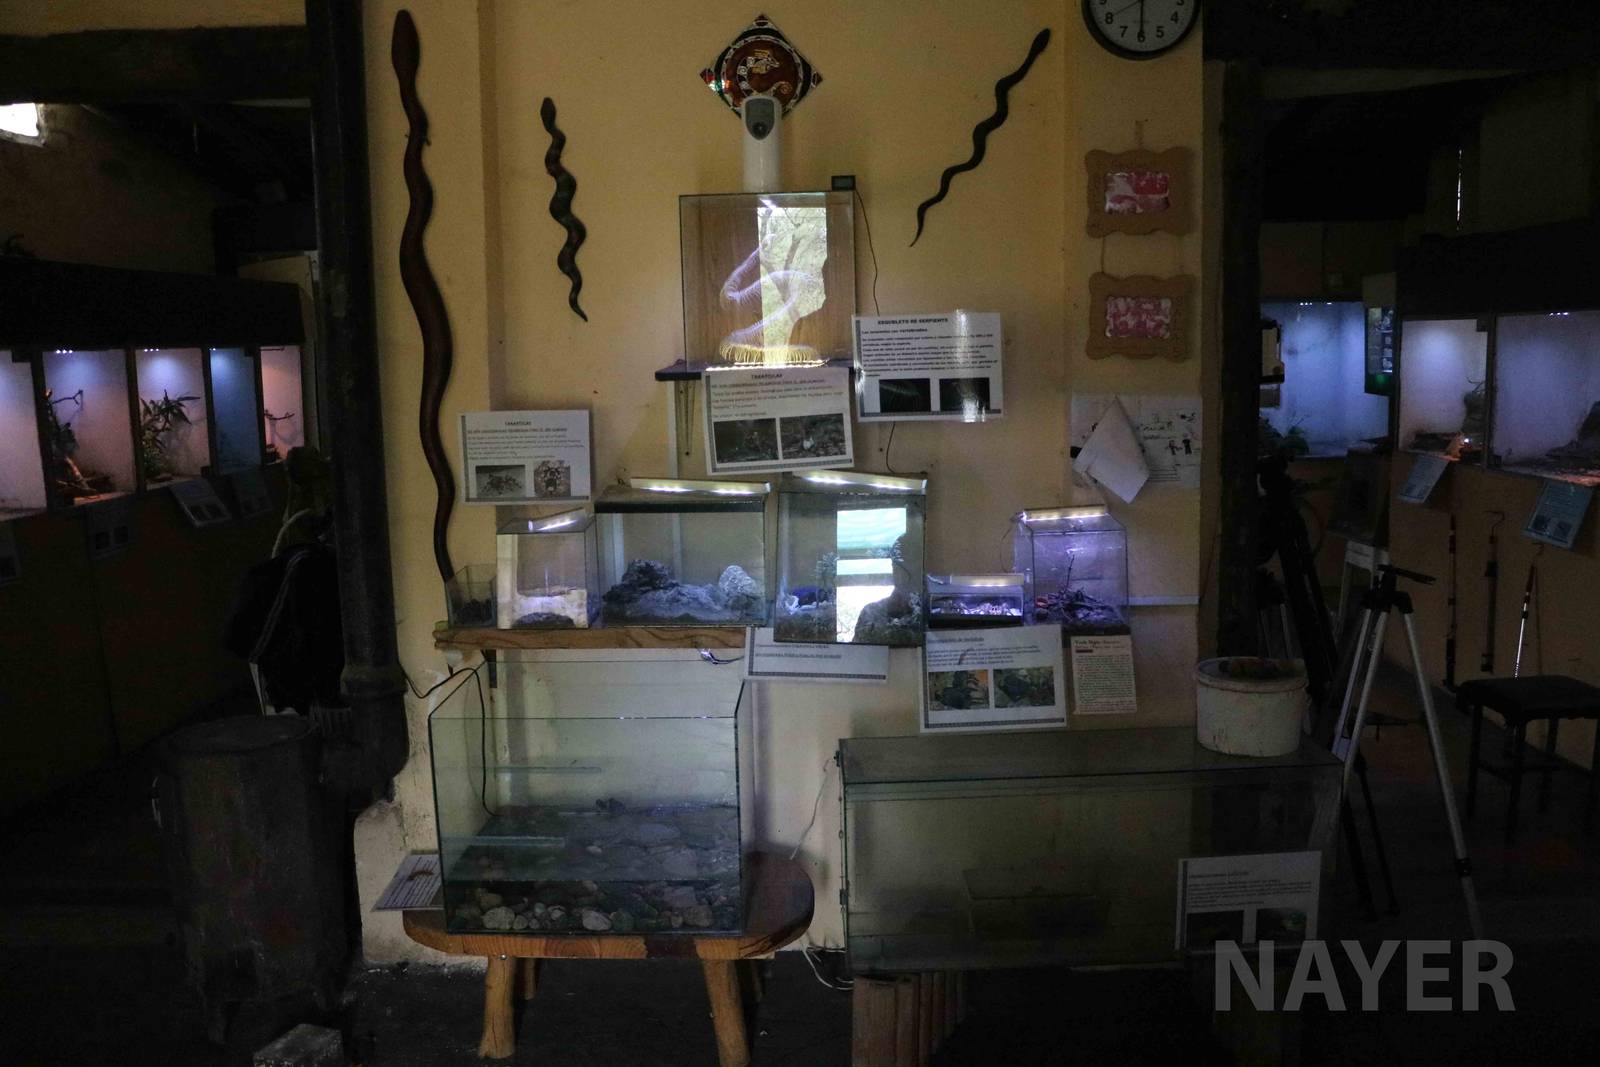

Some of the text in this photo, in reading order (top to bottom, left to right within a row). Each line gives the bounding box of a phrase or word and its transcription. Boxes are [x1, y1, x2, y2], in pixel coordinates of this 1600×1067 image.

[1105, 12, 1113, 24] 8
[1171, 11, 1179, 24] 4
[1120, 26, 1128, 38] 7
[1137, 30, 1146, 42] 6
[1156, 26, 1164, 38] 5
